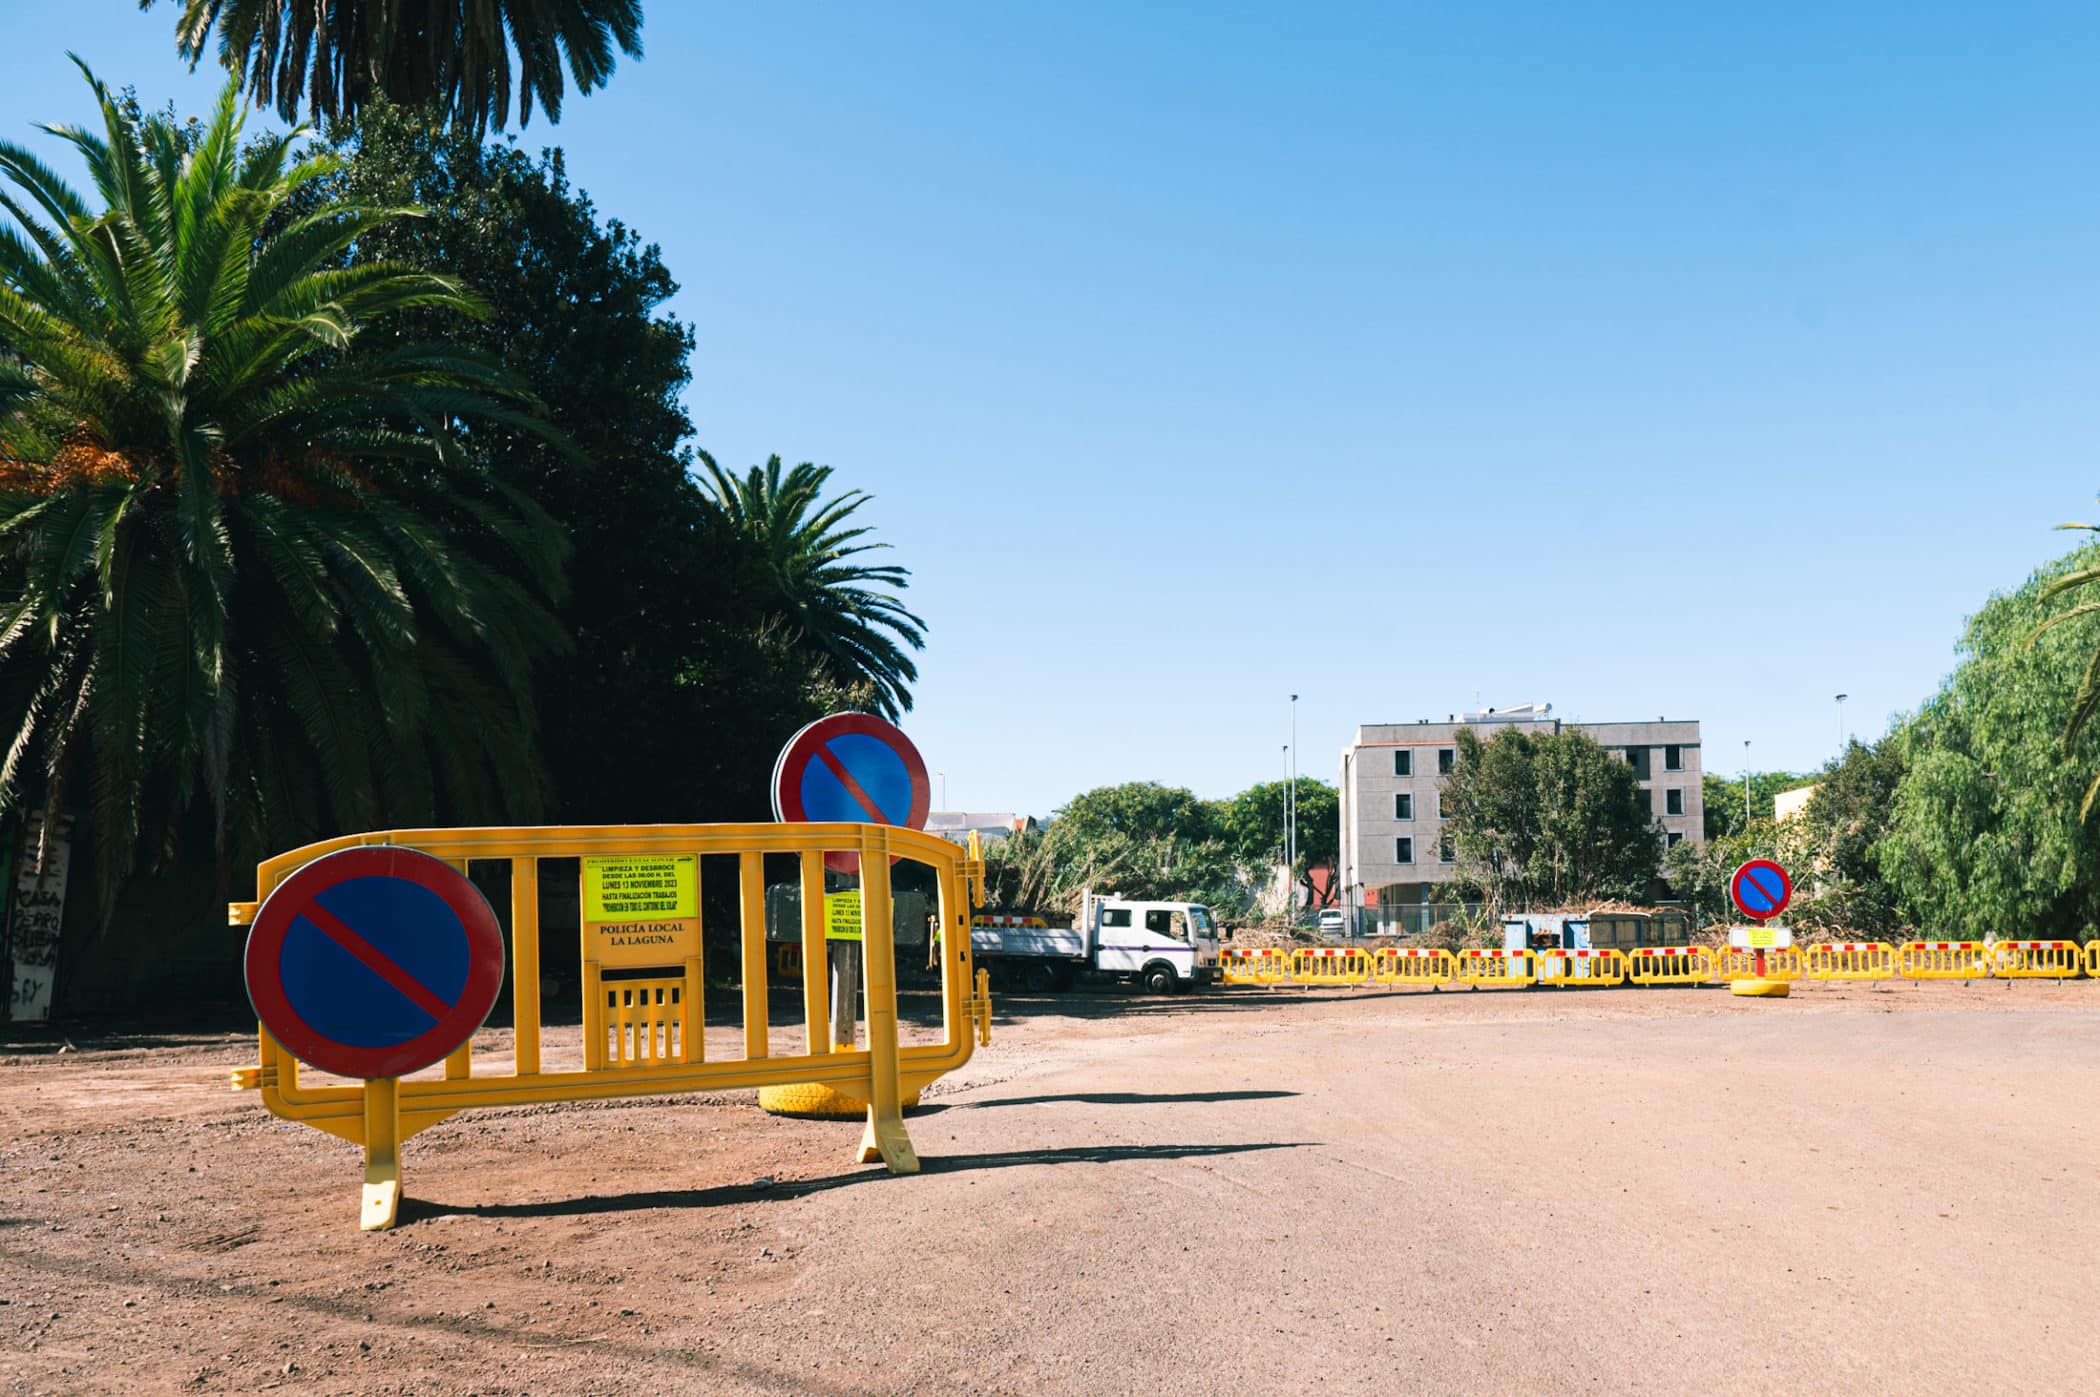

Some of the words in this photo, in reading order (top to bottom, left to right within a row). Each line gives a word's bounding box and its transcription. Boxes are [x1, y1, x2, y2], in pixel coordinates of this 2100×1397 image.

[602, 880, 620, 889] LUNES
[630, 879, 662, 888] NOVIEMBRE
[600, 923, 645, 935] POLICÍA
[648, 923, 684, 932] LOCAL
[611, 936, 625, 946] LA
[627, 935, 674, 945] LAGUNA
